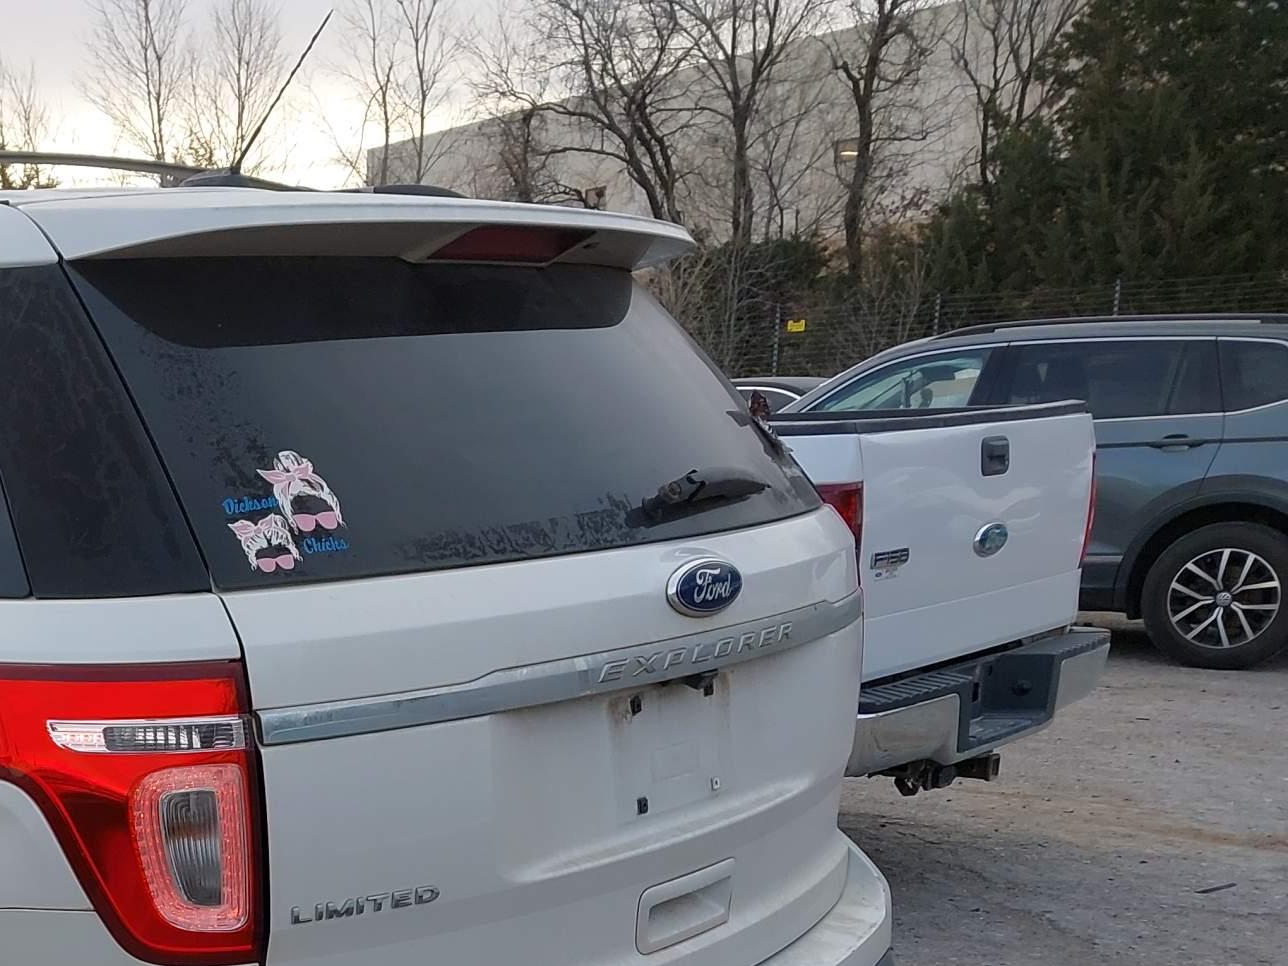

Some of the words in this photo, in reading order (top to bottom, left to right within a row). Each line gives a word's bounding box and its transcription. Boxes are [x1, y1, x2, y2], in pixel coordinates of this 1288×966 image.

[222, 495, 279, 515] Dickson
[301, 536, 349, 553] Chicks
[693, 568, 733, 604] Ford
[597, 621, 794, 683] EXPLORER
[290, 884, 441, 925] LIMITED
